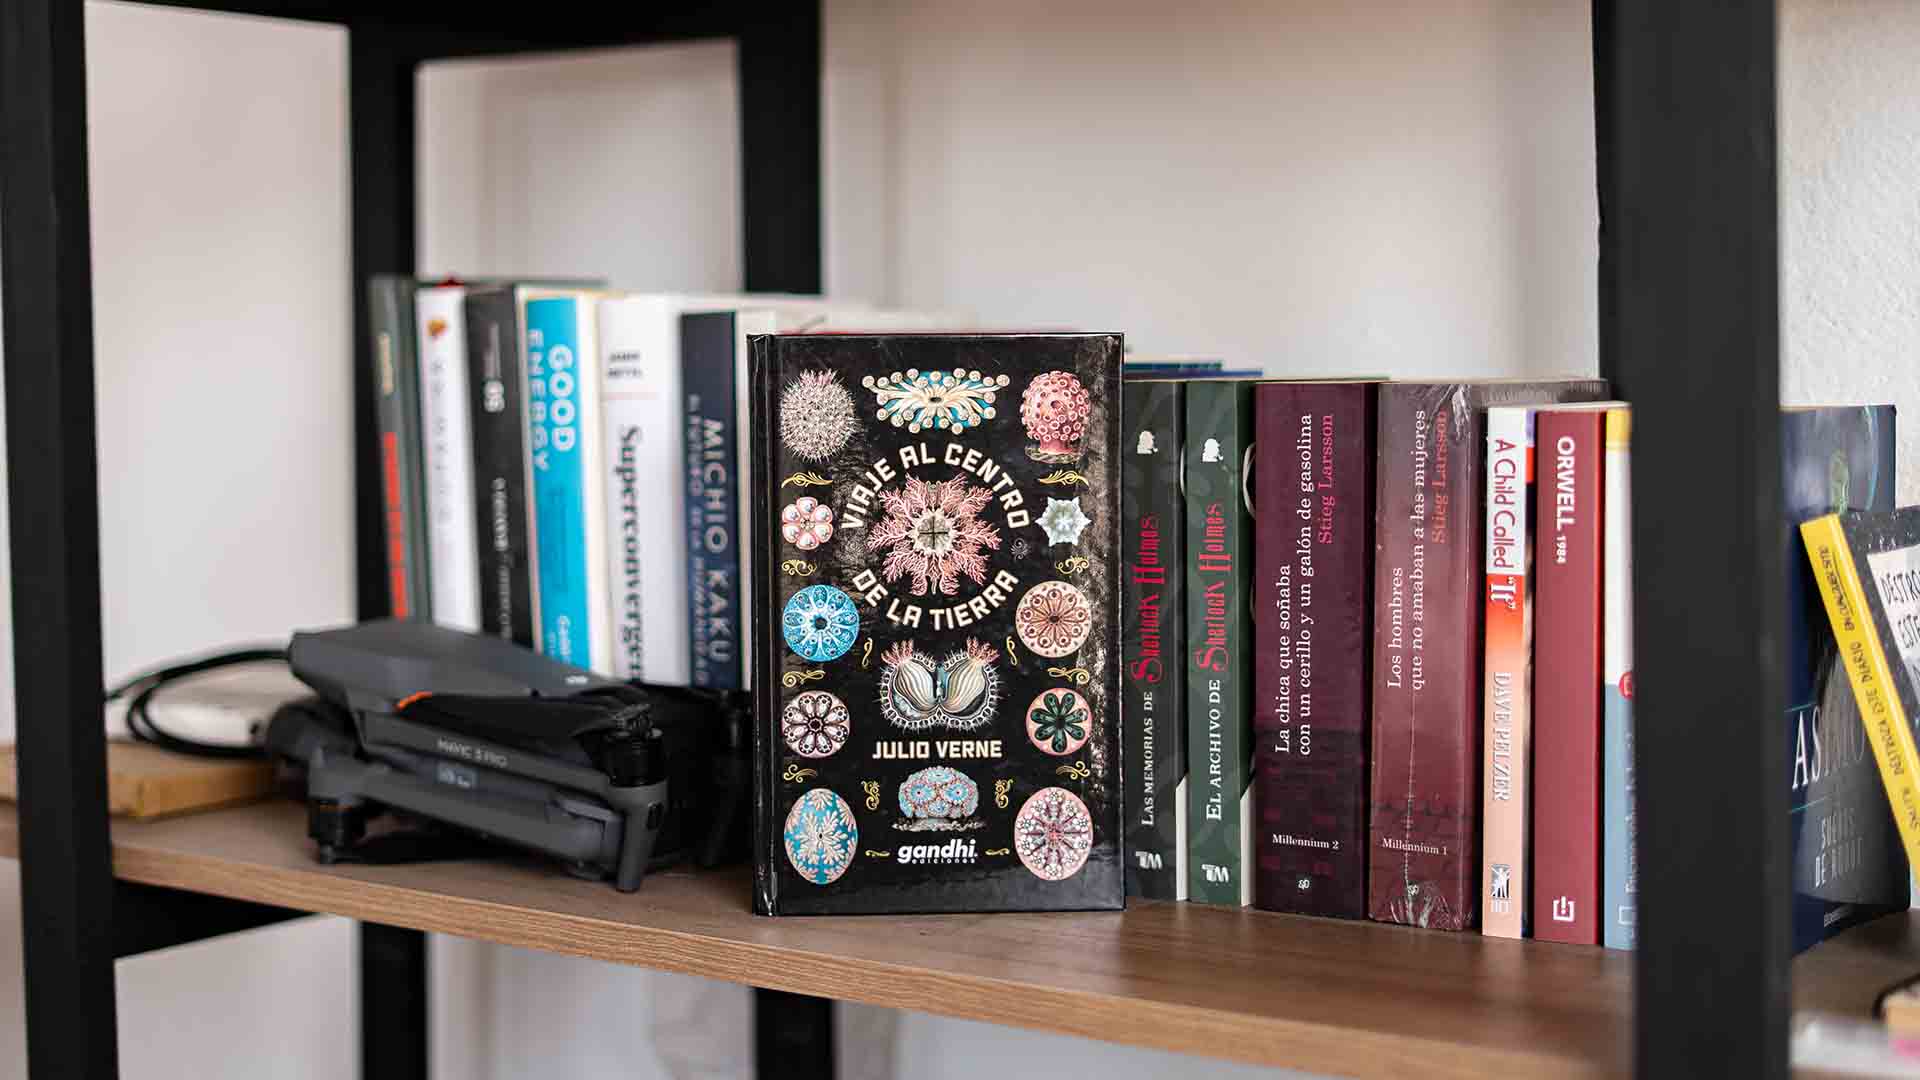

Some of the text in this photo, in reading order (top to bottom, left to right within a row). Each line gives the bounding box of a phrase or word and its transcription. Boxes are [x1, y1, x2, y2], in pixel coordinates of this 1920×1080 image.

[527, 329, 550, 471] ENERGY
[548, 343, 576, 452] GOOD
[840, 442, 1030, 529] VIAJE AL CENTRO
[1317, 414, 1336, 545] Stieg Larsson
[1431, 409, 1449, 545] Stieg Larsson
[1494, 438, 1517, 453] A
[1494, 458, 1517, 505] Child
[1492, 509, 1517, 569] Called
[1556, 436, 1576, 564] ORWELL 1984
[703, 419, 732, 663] MICHIO KAKU
[1409, 410, 1429, 690] que no amaban a las mujeres
[852, 568, 1019, 631] DE LA TIERRA
[1296, 414, 1315, 756] con un cerillo y un galón de gasolina
[1275, 564, 1295, 753] La chica que soñaba
[1387, 567, 1403, 688] Los hombres
[1143, 691, 1153, 711] DE
[1208, 679, 1221, 703] DE
[871, 739, 1003, 760] JULIO VERNE
[1142, 717, 1154, 794] MEMORIAS
[1208, 708, 1222, 788] ARCHIVO
[1491, 671, 1513, 802] DAVE PELZER
[1140, 796, 1154, 826] LAS
[1206, 792, 1222, 820] EL
[1271, 833, 1340, 850] Millennium 2
[1381, 837, 1449, 857] Millennium 1
